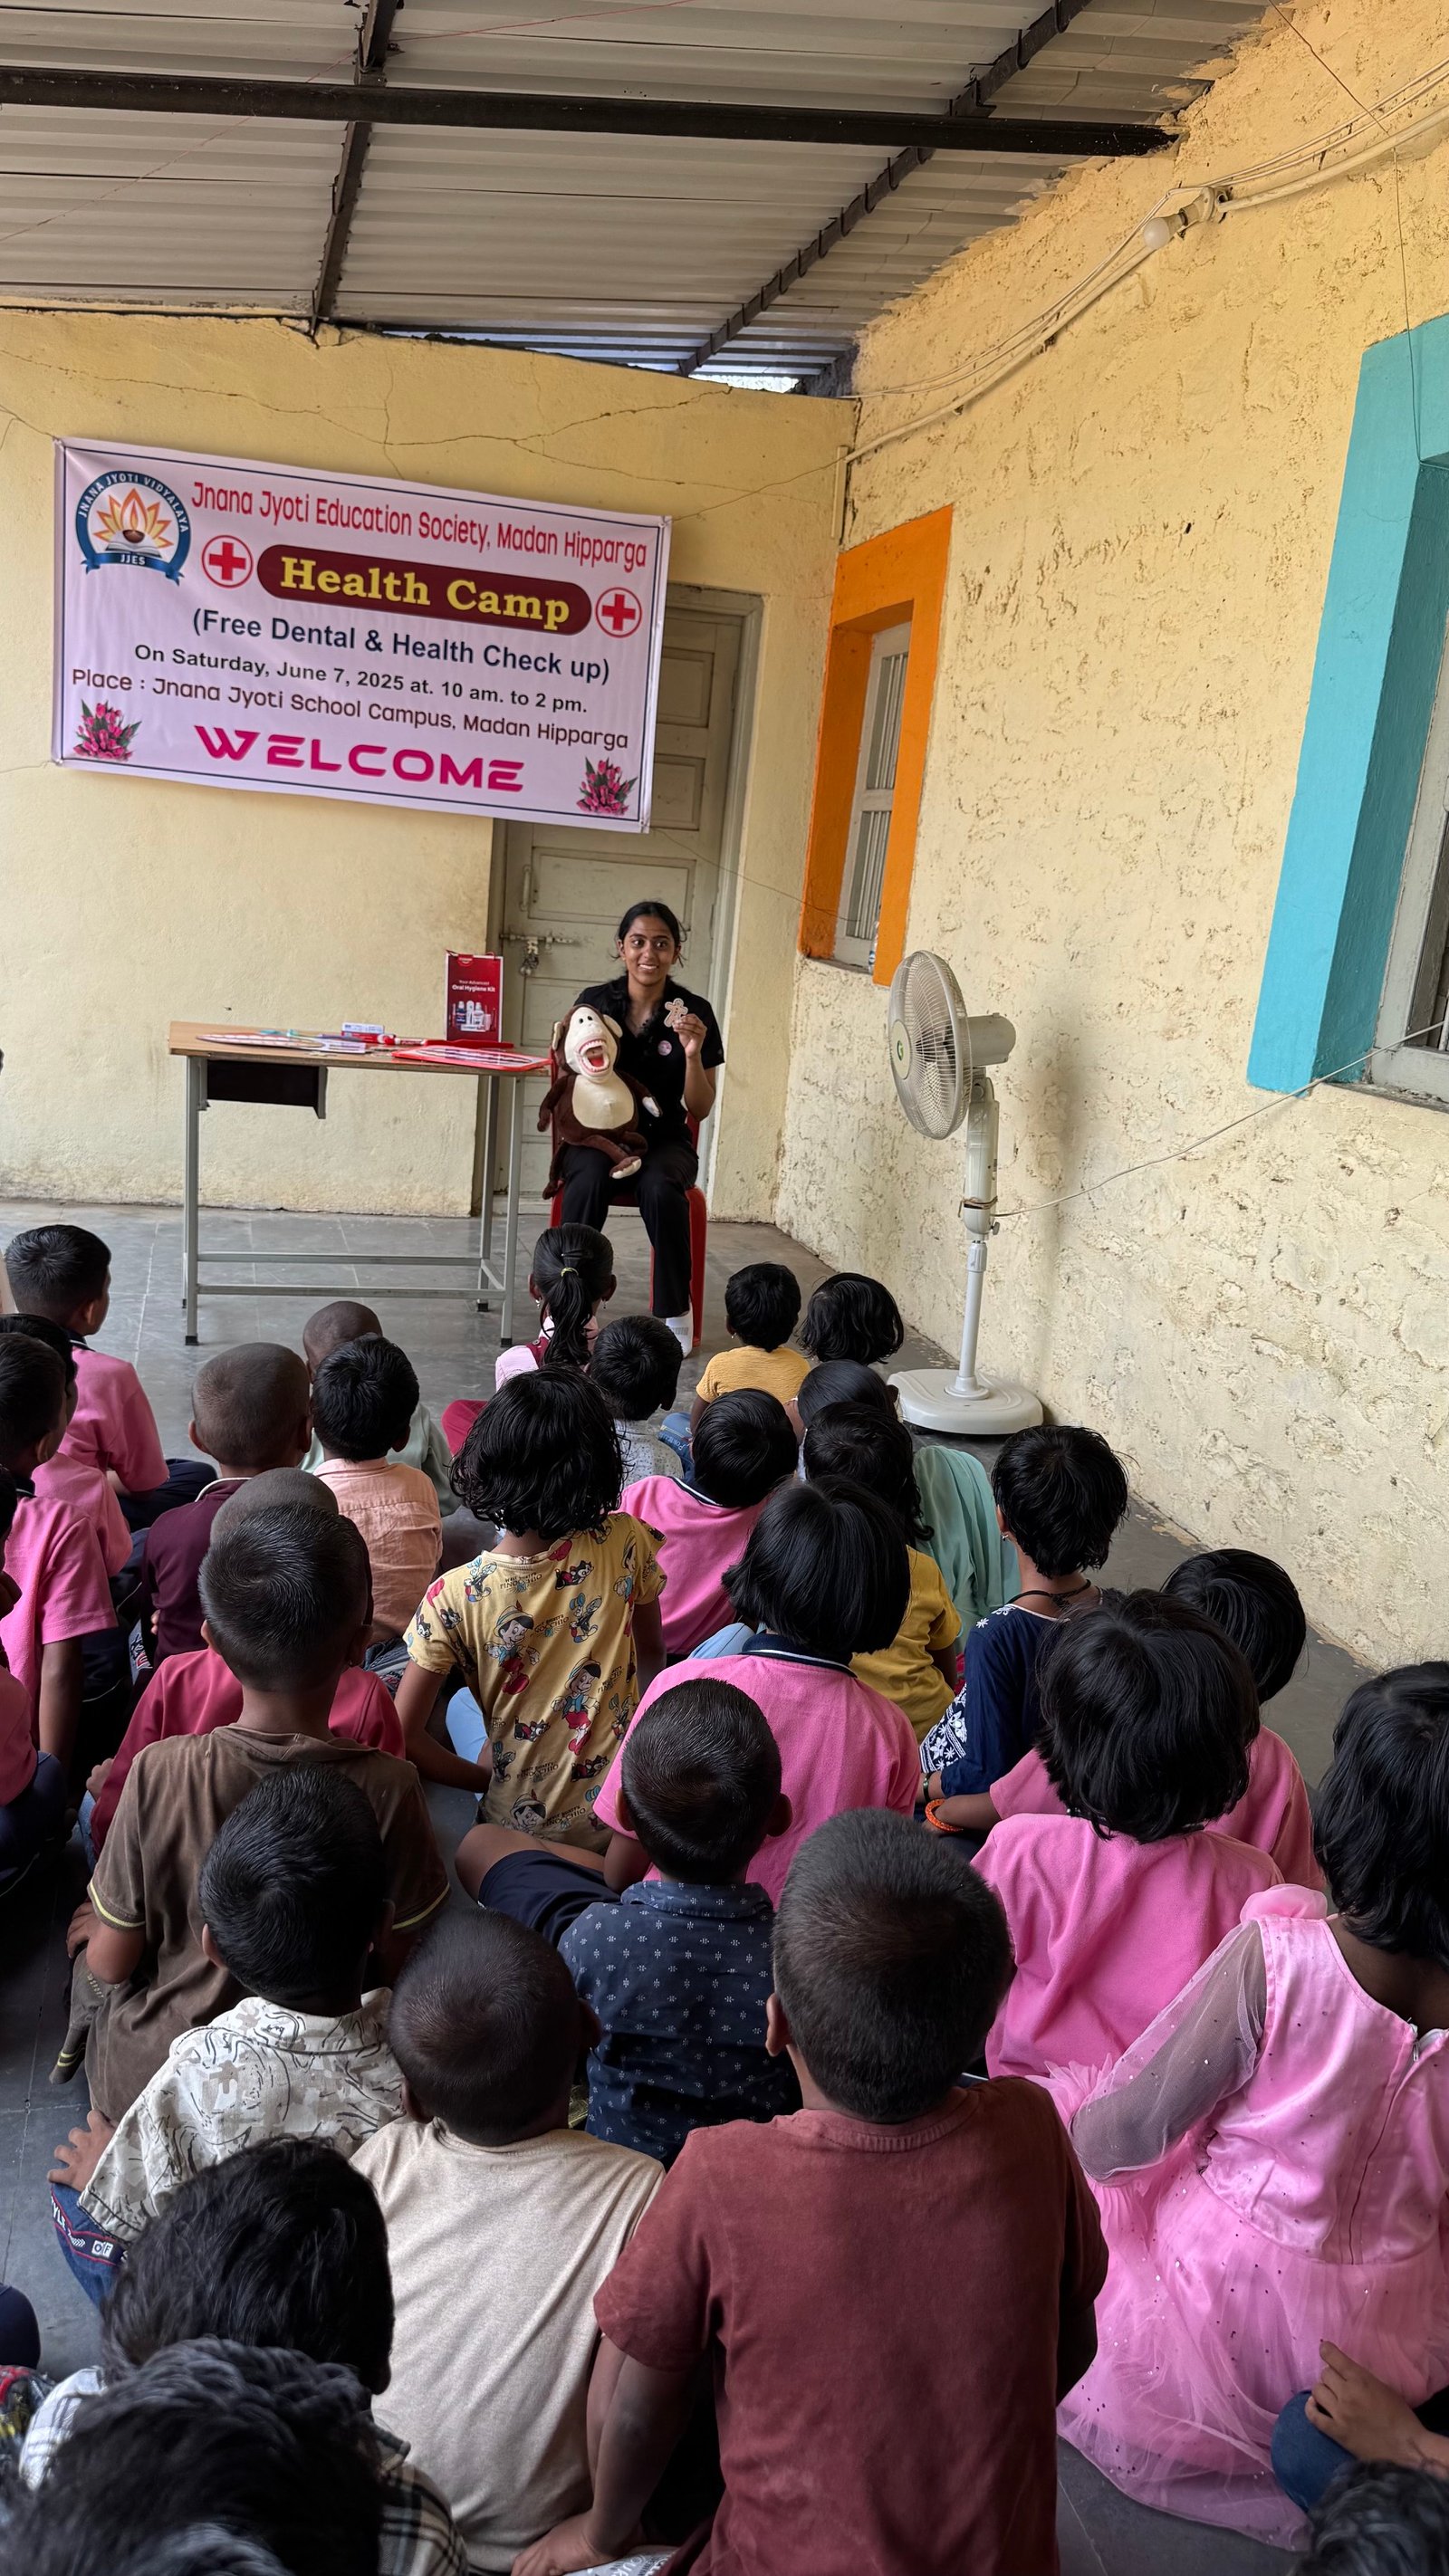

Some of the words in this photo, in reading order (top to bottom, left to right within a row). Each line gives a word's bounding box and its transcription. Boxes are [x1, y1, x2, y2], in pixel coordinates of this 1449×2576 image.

[78, 482, 104, 518] JNANA
[105, 473, 139, 485] JYOTI
[144, 477, 189, 532] VIDYALAYA
[191, 482, 253, 514] Jnana
[259, 490, 309, 526] Jyoti
[316, 497, 412, 536] Education
[418, 511, 491, 553] Society,
[497, 522, 558, 555] Madan
[564, 531, 647, 573] Hipparga
[120, 554, 146, 566] JJES
[280, 556, 431, 606] Health
[446, 579, 570, 630] Camp
[134, 644, 165, 662] On
[172, 648, 270, 677] Saturday,
[276, 661, 327, 681] June
[333, 667, 350, 687] 7,
[357, 671, 404, 691] 2025
[409, 680, 434, 695] at.
[441, 681, 463, 697] 10
[469, 687, 504, 704] am.
[510, 690, 529, 706] to
[535, 693, 547, 708] 2
[552, 697, 588, 713] pm.
[193, 608, 262, 637] (Free
[271, 618, 356, 648] Dental
[364, 629, 384, 653] &
[393, 632, 474, 664] Health
[483, 644, 562, 675] Check
[571, 658, 609, 685] up)
[72, 668, 133, 691] Place
[152, 677, 221, 702] Jnana
[227, 686, 283, 709] Jyoti
[290, 694, 361, 718] School
[368, 702, 456, 730] Campus,
[463, 714, 531, 737] Madan
[537, 722, 629, 751] Hipparga
[194, 724, 524, 792] WELCOME
[93, 2241, 112, 2256] OF
